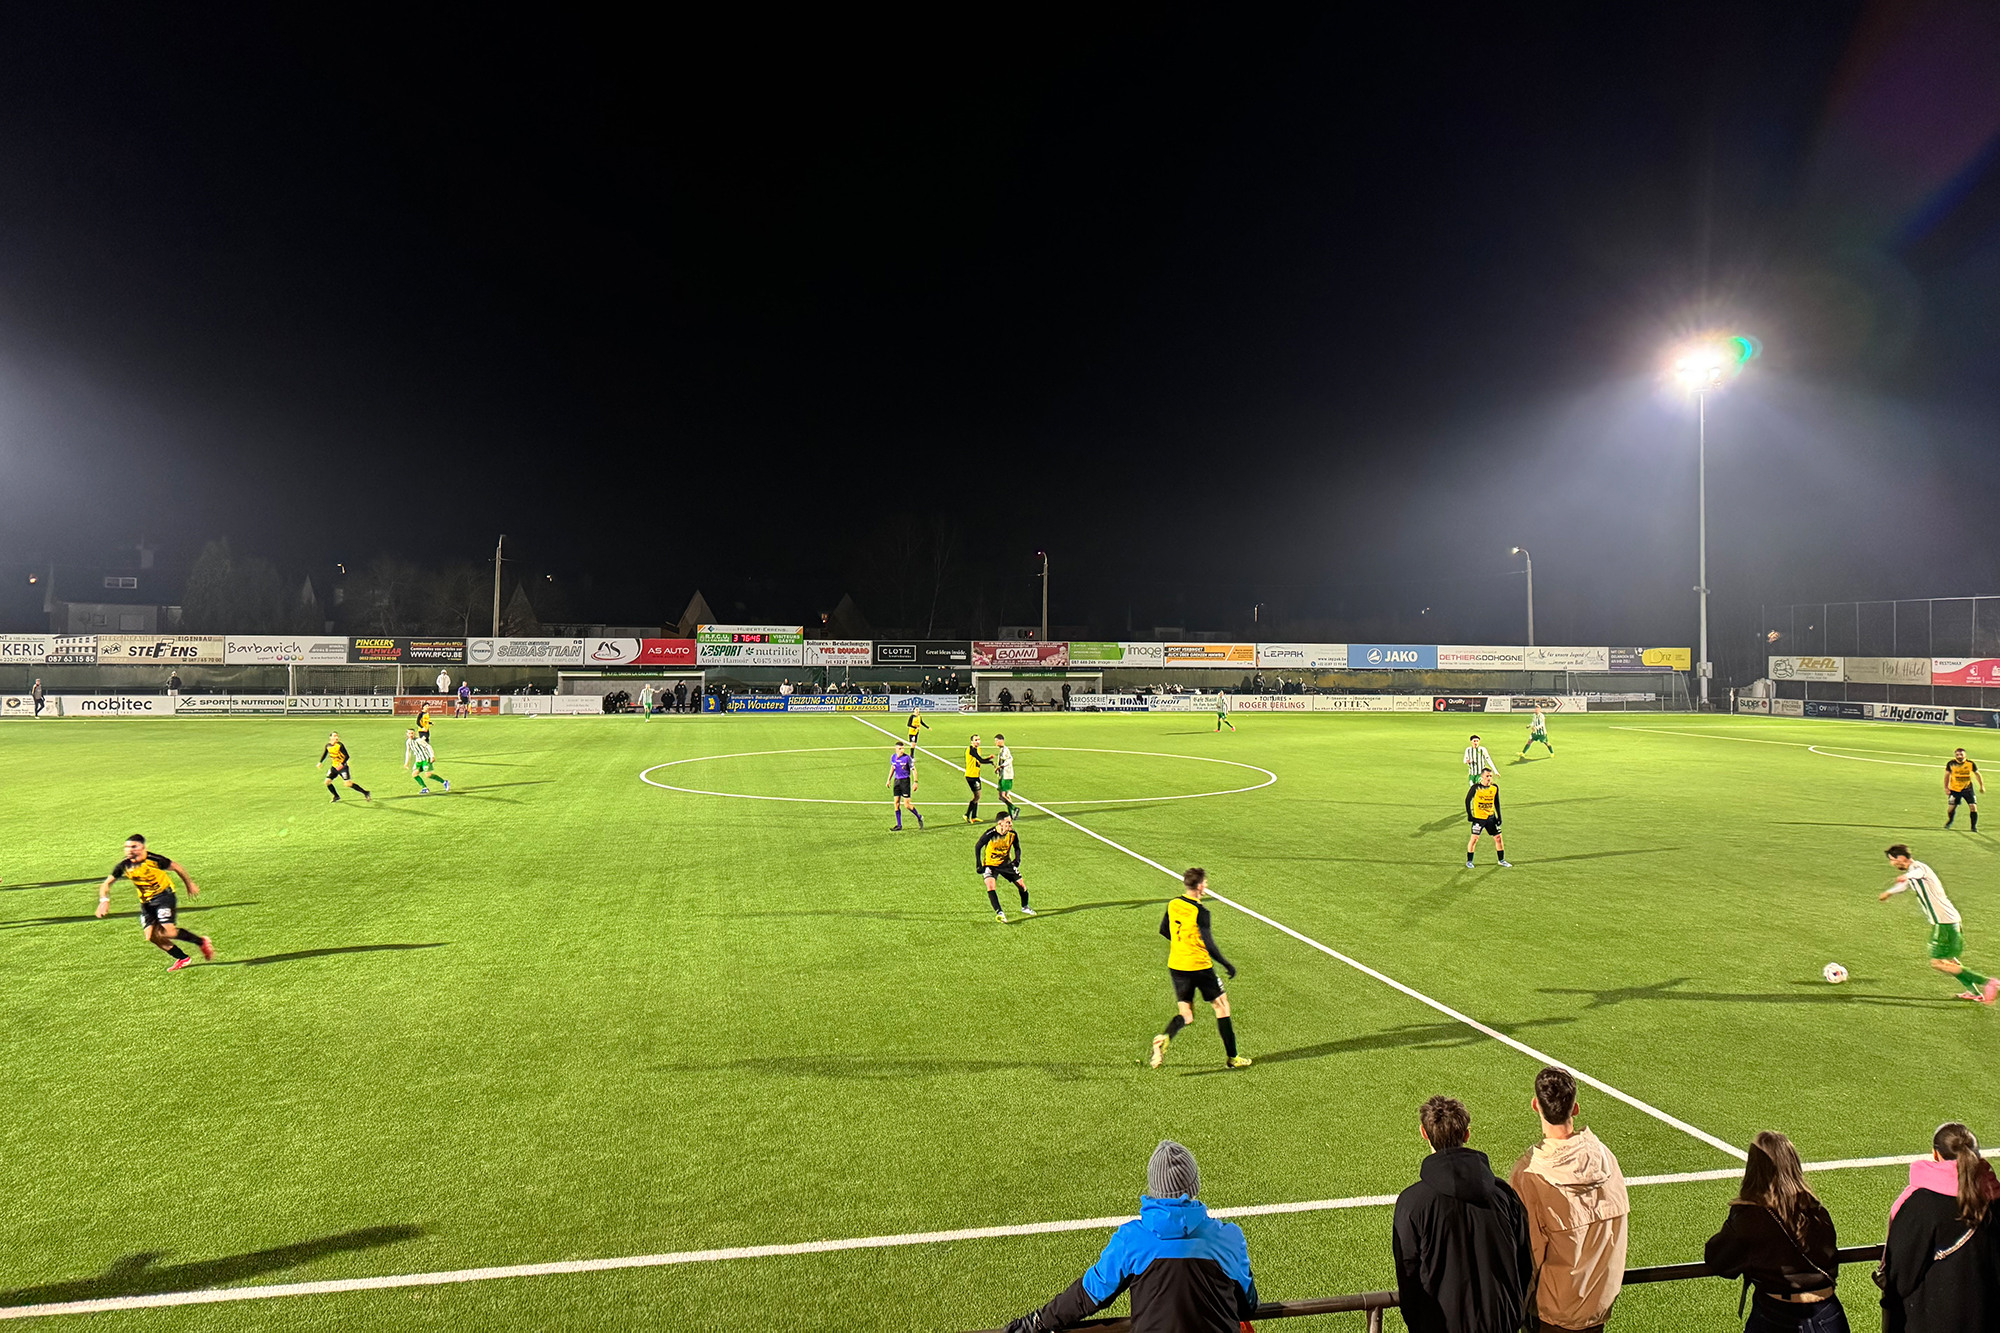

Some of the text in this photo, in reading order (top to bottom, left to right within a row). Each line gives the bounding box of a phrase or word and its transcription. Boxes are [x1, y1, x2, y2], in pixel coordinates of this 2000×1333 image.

[355, 639, 394, 648] PINCKERS
[733, 634, 739, 642] 3
[2, 644, 45, 656] KERIS
[128, 638, 198, 658] STEFFENS
[227, 642, 302, 654] Barbarich
[360, 648, 402, 656] TEAMWEAR
[497, 645, 582, 657] SEBASTIAN
[755, 647, 798, 656] nutrilite
[998, 649, 1036, 658] BONNI
[1128, 644, 1162, 656] image
[1263, 650, 1304, 658] LEPPAK
[1384, 650, 1418, 662] JAKO
[82, 697, 152, 711] mobitec
[300, 698, 390, 707] NUTRILITE
[788, 695, 888, 705] HEIZUNG SANITÄR BÄDER
[1740, 699, 1761, 708] super
[727, 700, 785, 712] alph Wouters
[1889, 706, 1949, 721] Hydromat
